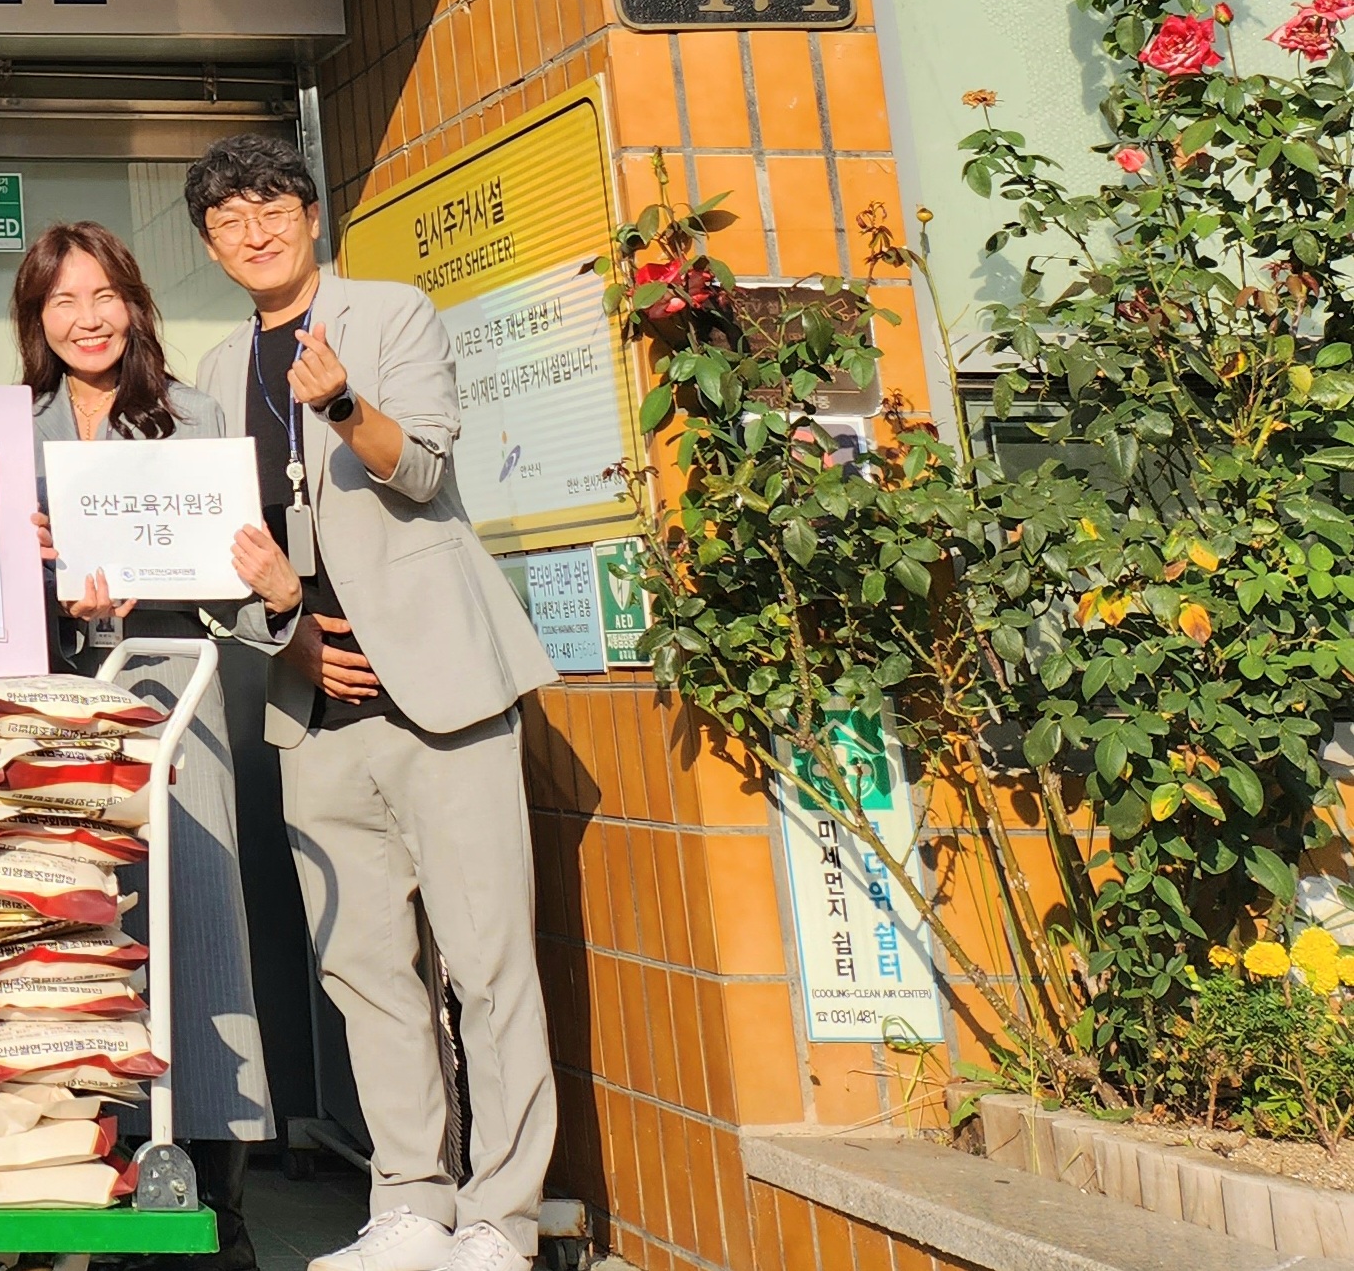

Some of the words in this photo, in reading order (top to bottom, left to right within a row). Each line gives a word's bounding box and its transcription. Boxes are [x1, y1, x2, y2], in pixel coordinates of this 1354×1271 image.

[414, 176, 505, 259] 임시주거시설
[466, 231, 516, 277] SHELTER)
[455, 327, 483, 359] 이곳은
[484, 319, 503, 349] 각종
[506, 311, 526, 341] 재난
[528, 303, 549, 336] 발생
[552, 296, 564, 327] 시
[470, 372, 499, 406] 이재민
[500, 344, 599, 399] 임시주거시설입니다.
[519, 462, 542, 479] 안산시
[80, 493, 223, 517] 안산교육지원청
[133, 524, 174, 546] 기증
[573, 559, 593, 594] 쉼터
[535, 600, 562, 620] 미세먼지
[563, 599, 577, 619] 쉼터
[579, 598, 592, 618] 겸용
[615, 614, 634, 629] AED
[818, 820, 849, 923] 미세먼지
[832, 931, 856, 982] 쉼터
[873, 922, 902, 982] 쉼터
[883, 990, 896, 998] AIR
[898, 990, 932, 999] CENTER)
